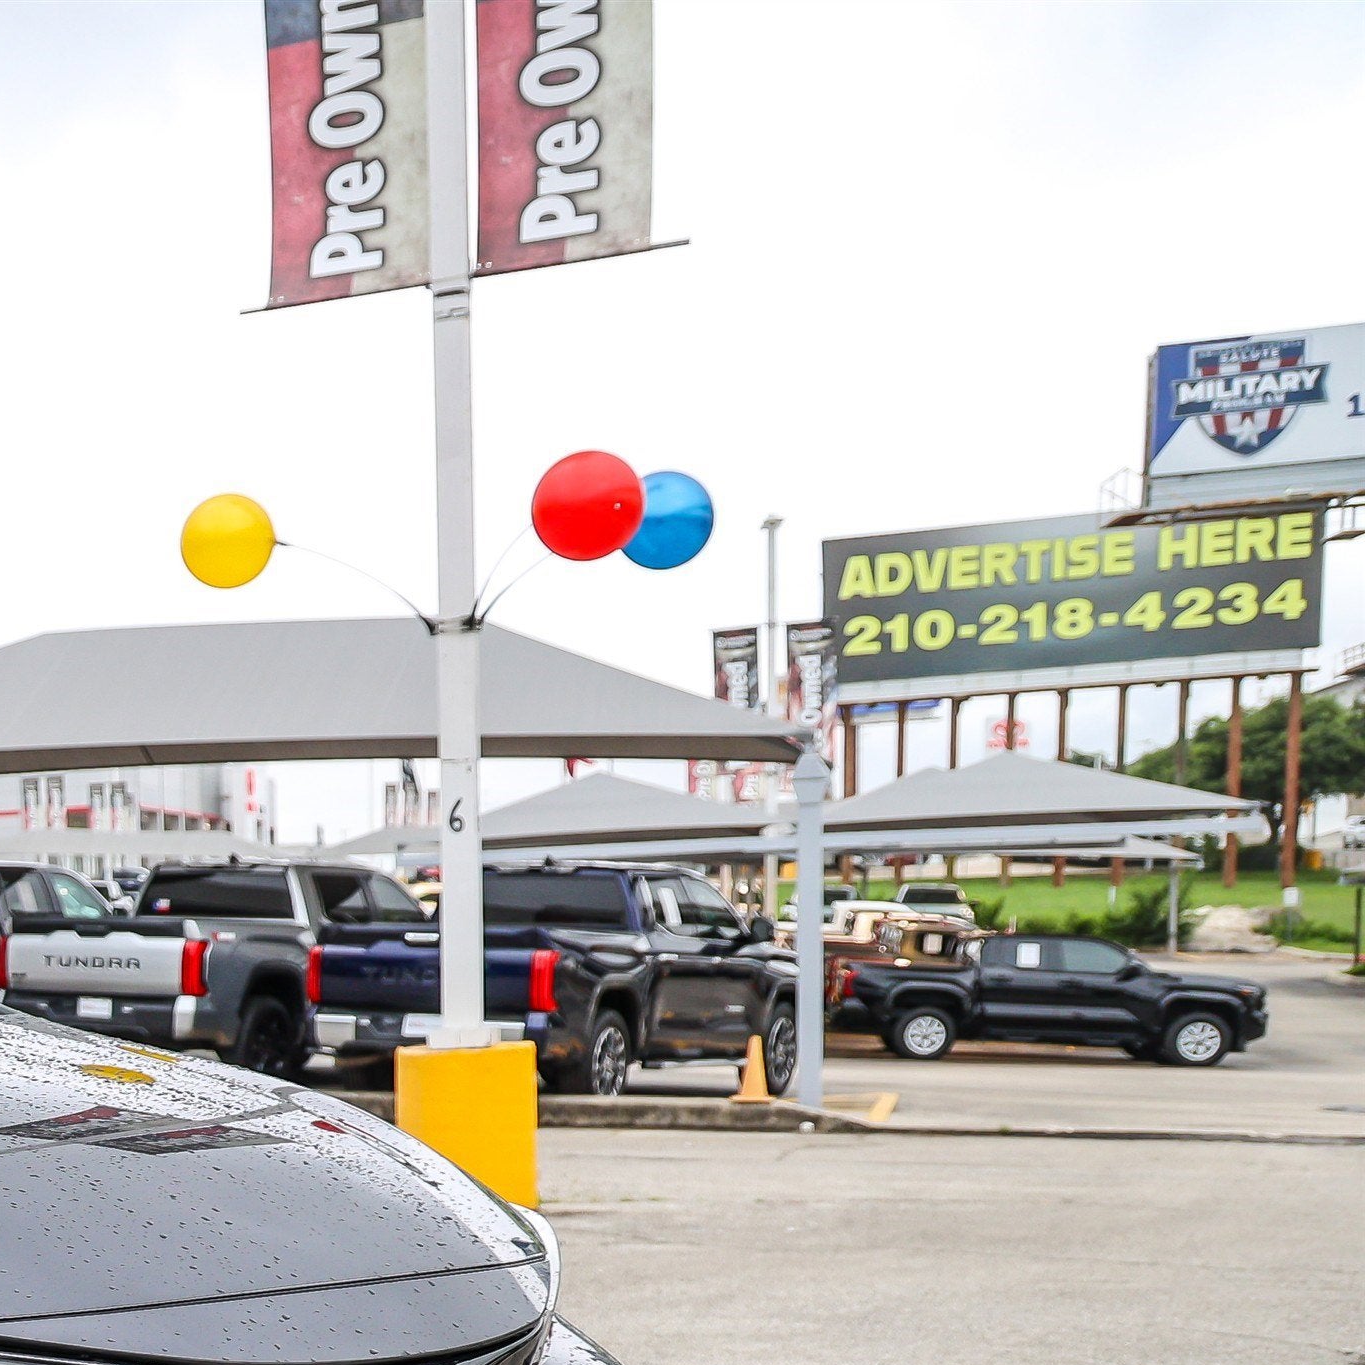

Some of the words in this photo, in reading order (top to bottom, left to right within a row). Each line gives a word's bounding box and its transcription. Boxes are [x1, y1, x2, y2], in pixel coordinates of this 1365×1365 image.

[310, 157, 386, 279] Pre
[519, 117, 602, 244] Pre
[1178, 367, 1321, 404] MILITARY
[836, 531, 1136, 601] ADVERTISE
[1156, 510, 1315, 572] HERE
[842, 577, 1308, 658] 210-218-4234
[449, 796, 464, 833] 6
[43, 954, 142, 971] TUNDRA
